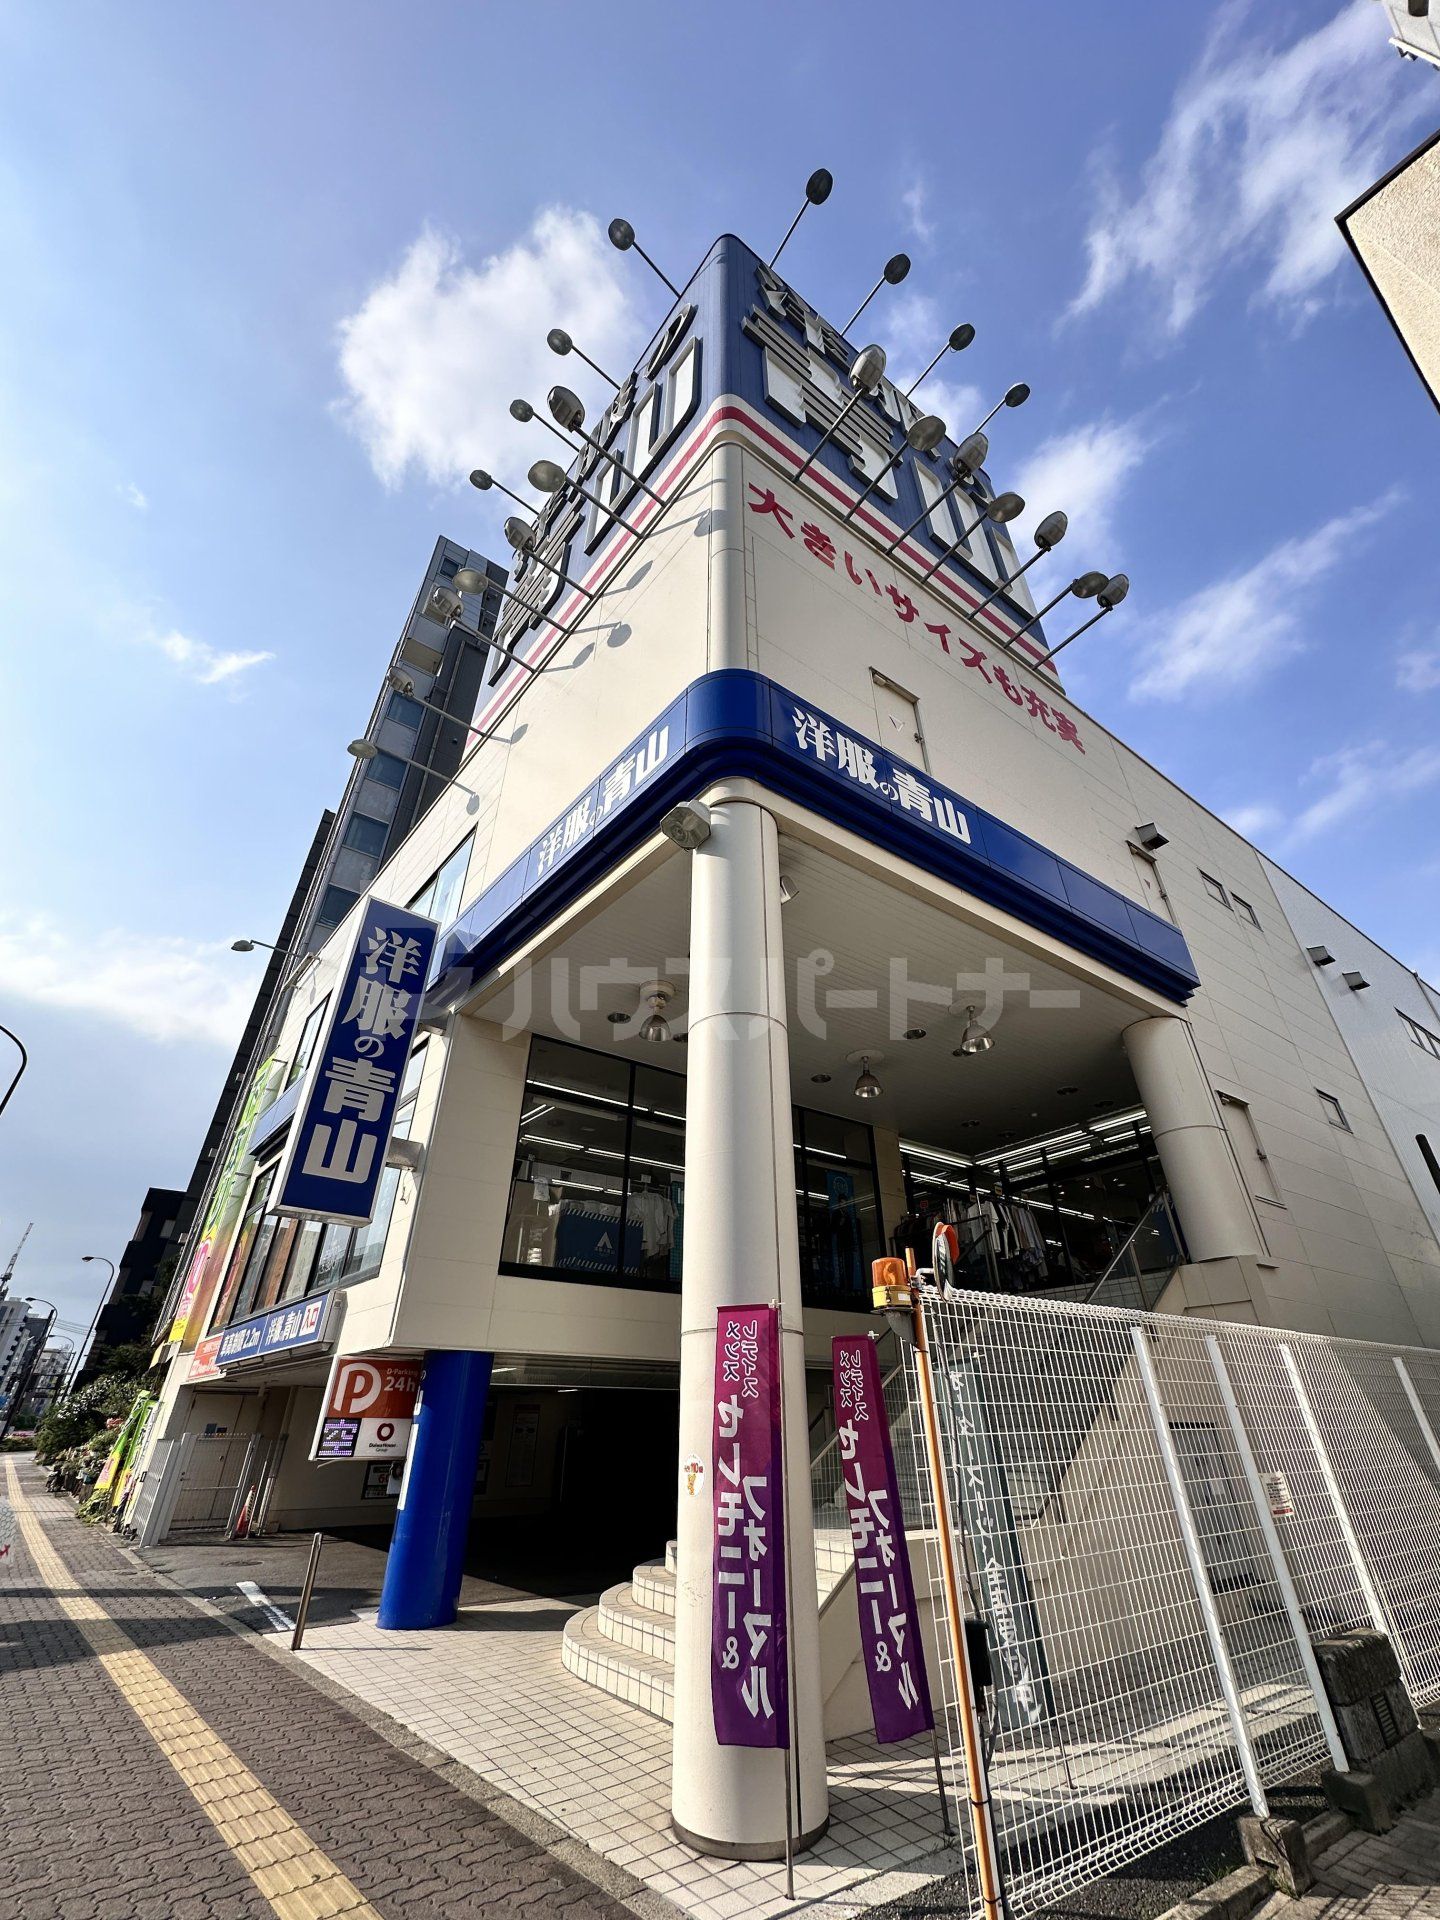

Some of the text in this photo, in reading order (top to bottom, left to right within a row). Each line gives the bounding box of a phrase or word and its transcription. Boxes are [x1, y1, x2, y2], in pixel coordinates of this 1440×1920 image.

[488, 336, 702, 688] 青山
[740, 304, 1043, 622] 青山
[746, 481, 1087, 755] 大きいサイズも充実
[537, 725, 669, 877] 洋服の青山
[791, 706, 972, 845] 洋服の青山
[302, 925, 422, 1184] 洋服の青山
[318, 1419, 359, 1456] 空
[383, 1375, 416, 1392] 24h
